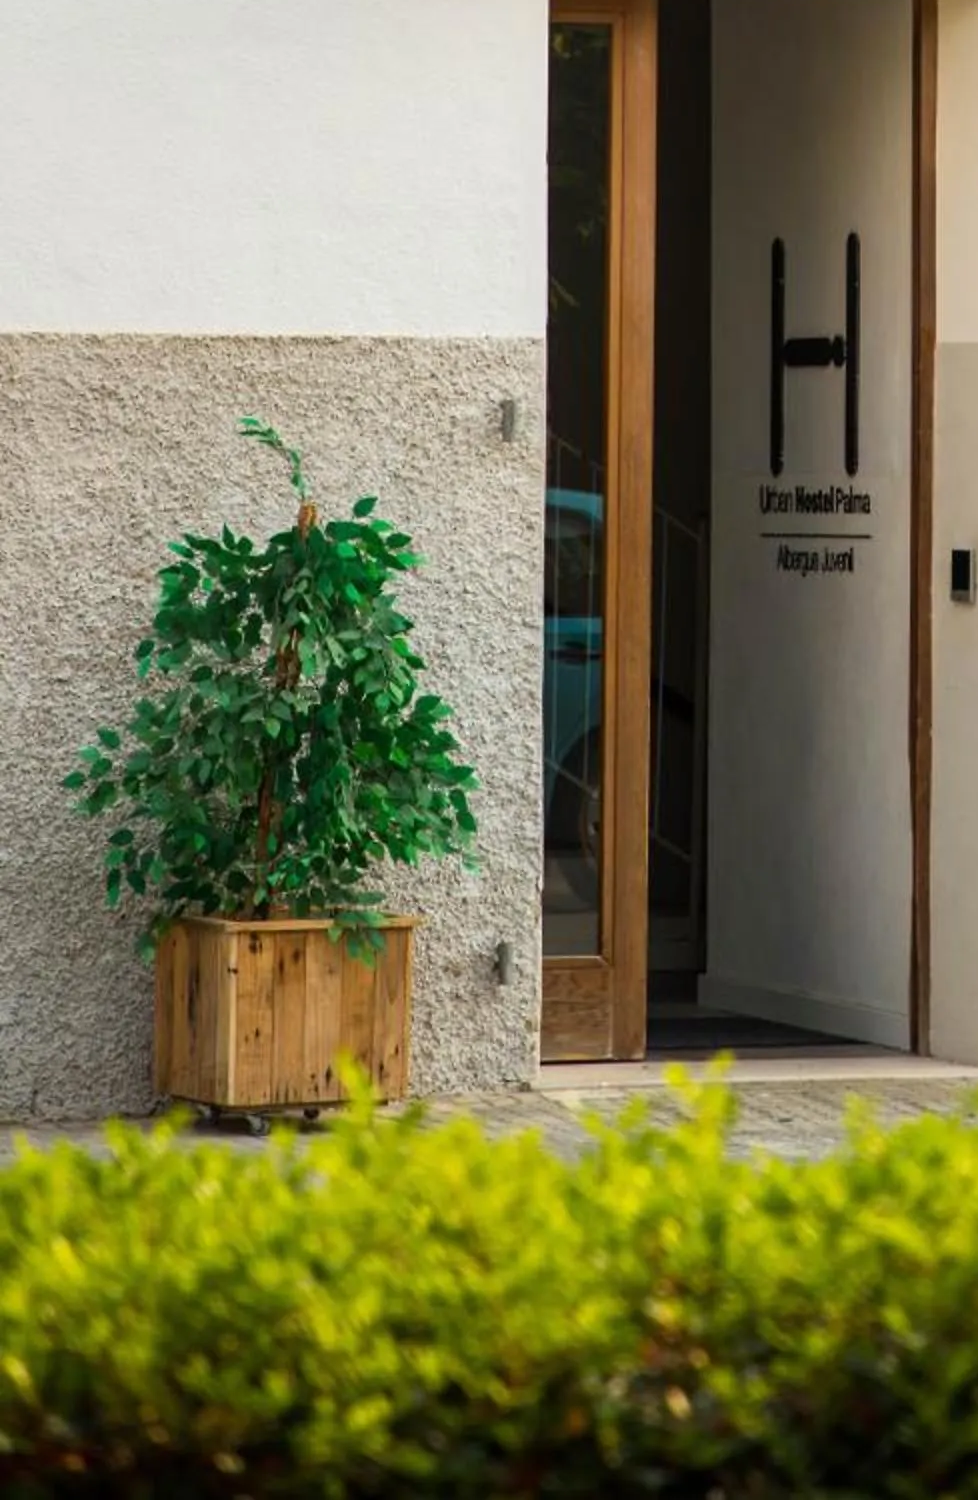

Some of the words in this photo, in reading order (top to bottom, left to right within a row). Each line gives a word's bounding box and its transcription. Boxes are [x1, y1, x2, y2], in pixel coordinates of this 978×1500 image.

[760, 483, 793, 515] Urban
[795, 485, 834, 514] Hostel
[836, 484, 871, 514] Palma
[777, 544, 819, 578] Albergue
